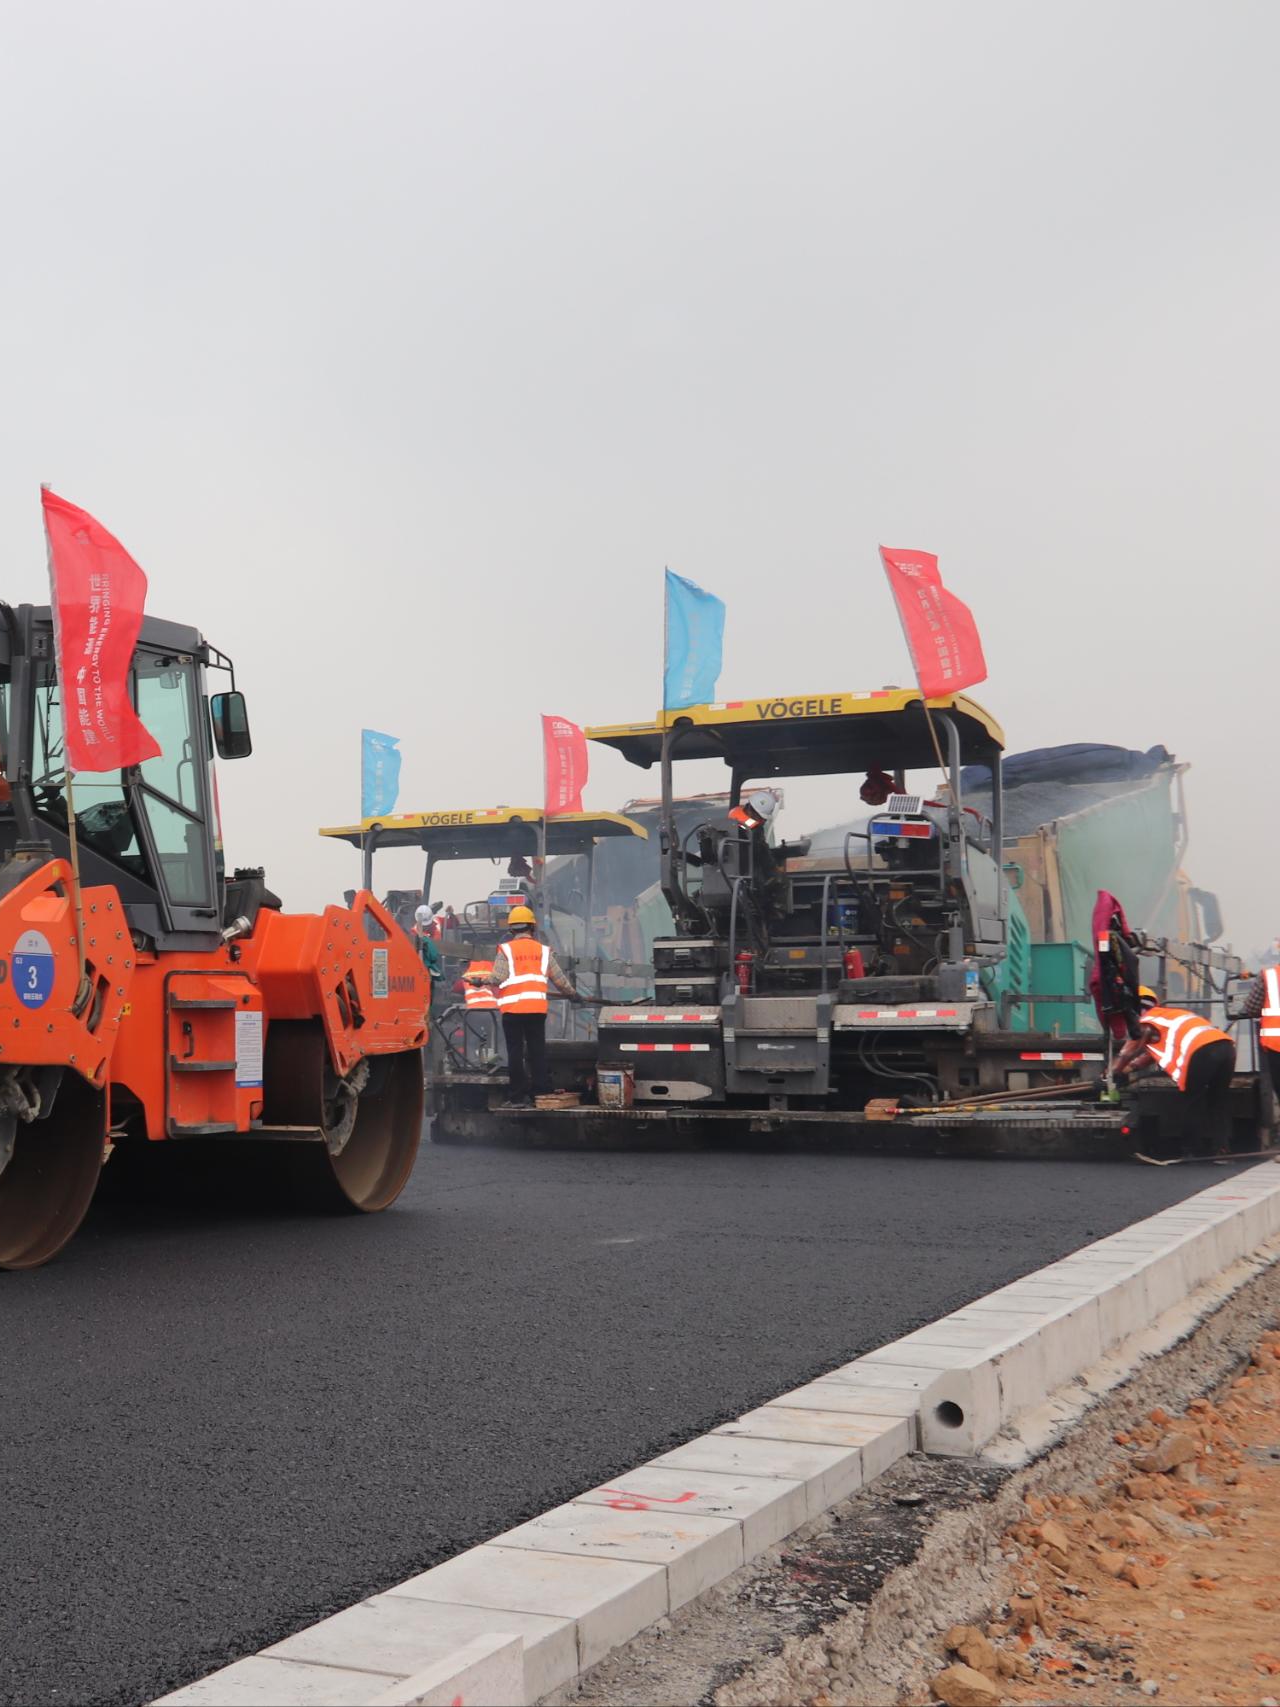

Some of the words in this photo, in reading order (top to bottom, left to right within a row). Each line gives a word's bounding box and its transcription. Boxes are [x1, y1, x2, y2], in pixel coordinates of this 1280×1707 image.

[91, 669, 102, 684] TO
[756, 698, 842, 719] VÖGELE
[28, 966, 38, 989] 3
